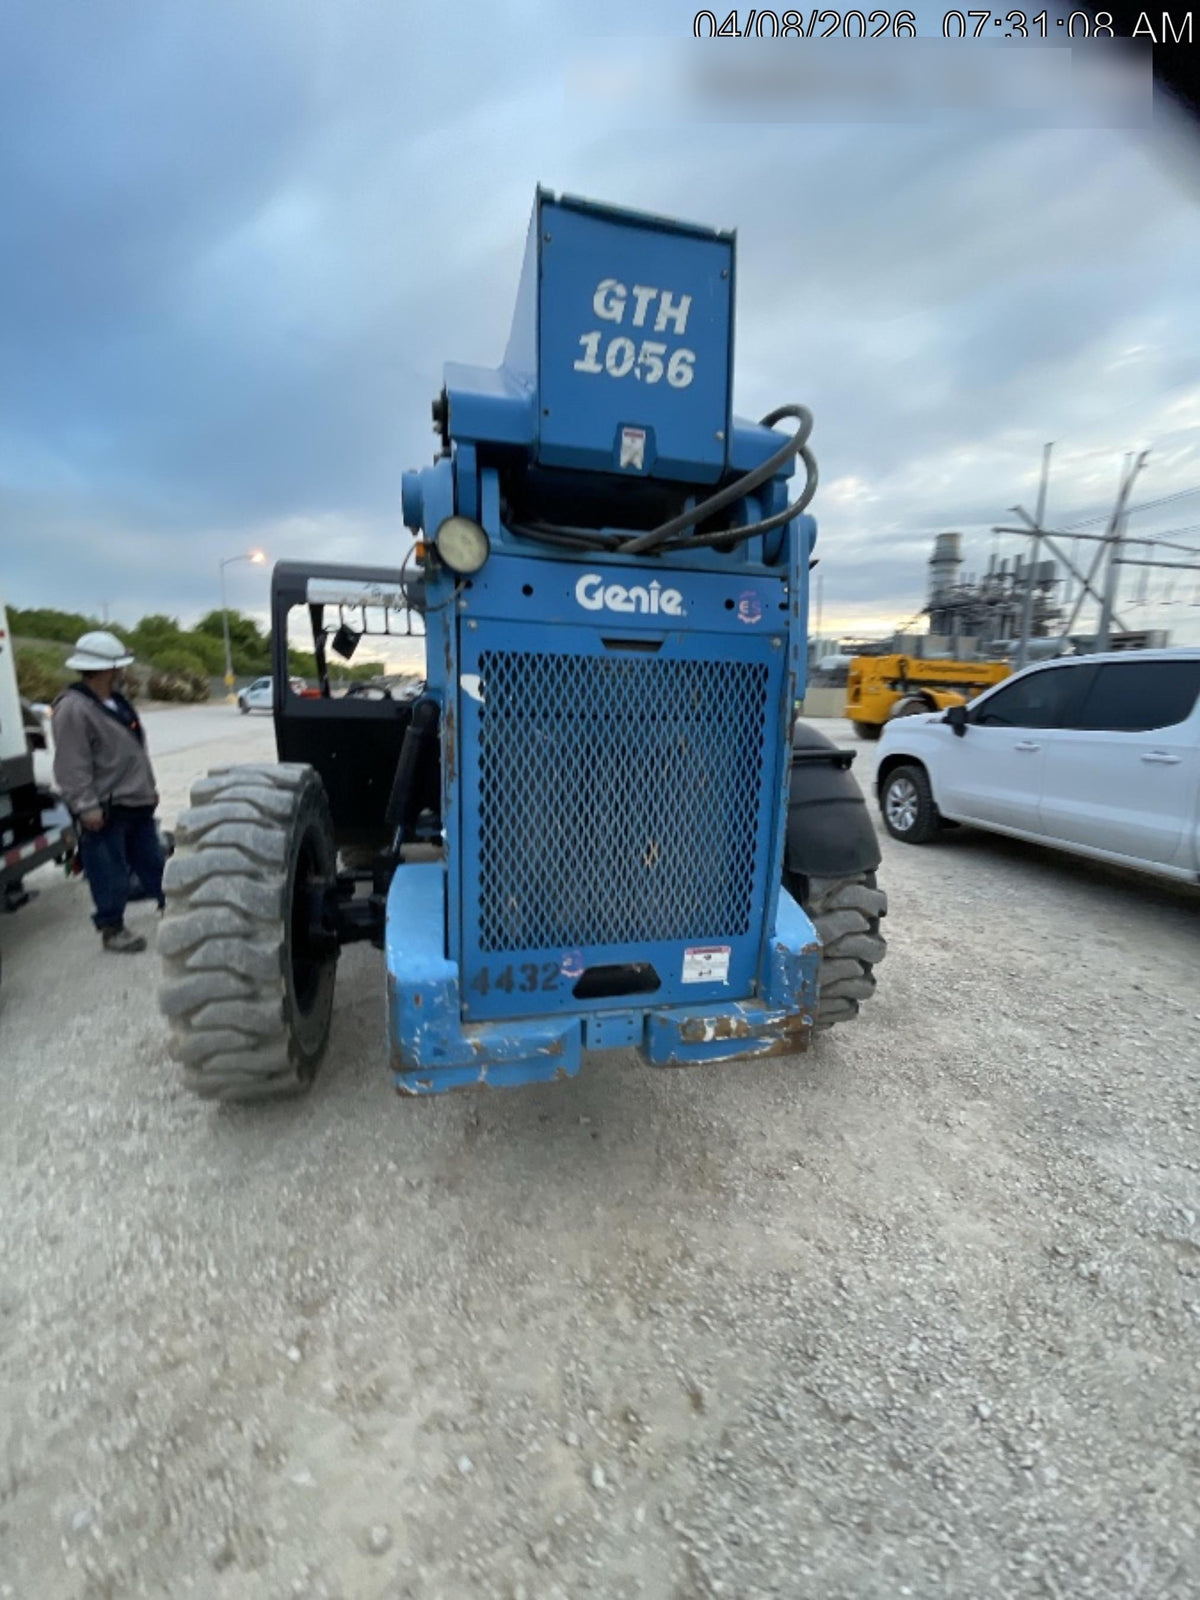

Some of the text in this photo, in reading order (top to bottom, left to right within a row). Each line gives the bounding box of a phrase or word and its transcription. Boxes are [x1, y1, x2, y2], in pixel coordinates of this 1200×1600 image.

[593, 278, 692, 334] GTH
[573, 331, 696, 388] 1056
[575, 573, 682, 616] Genie
[471, 962, 559, 995] 4432
